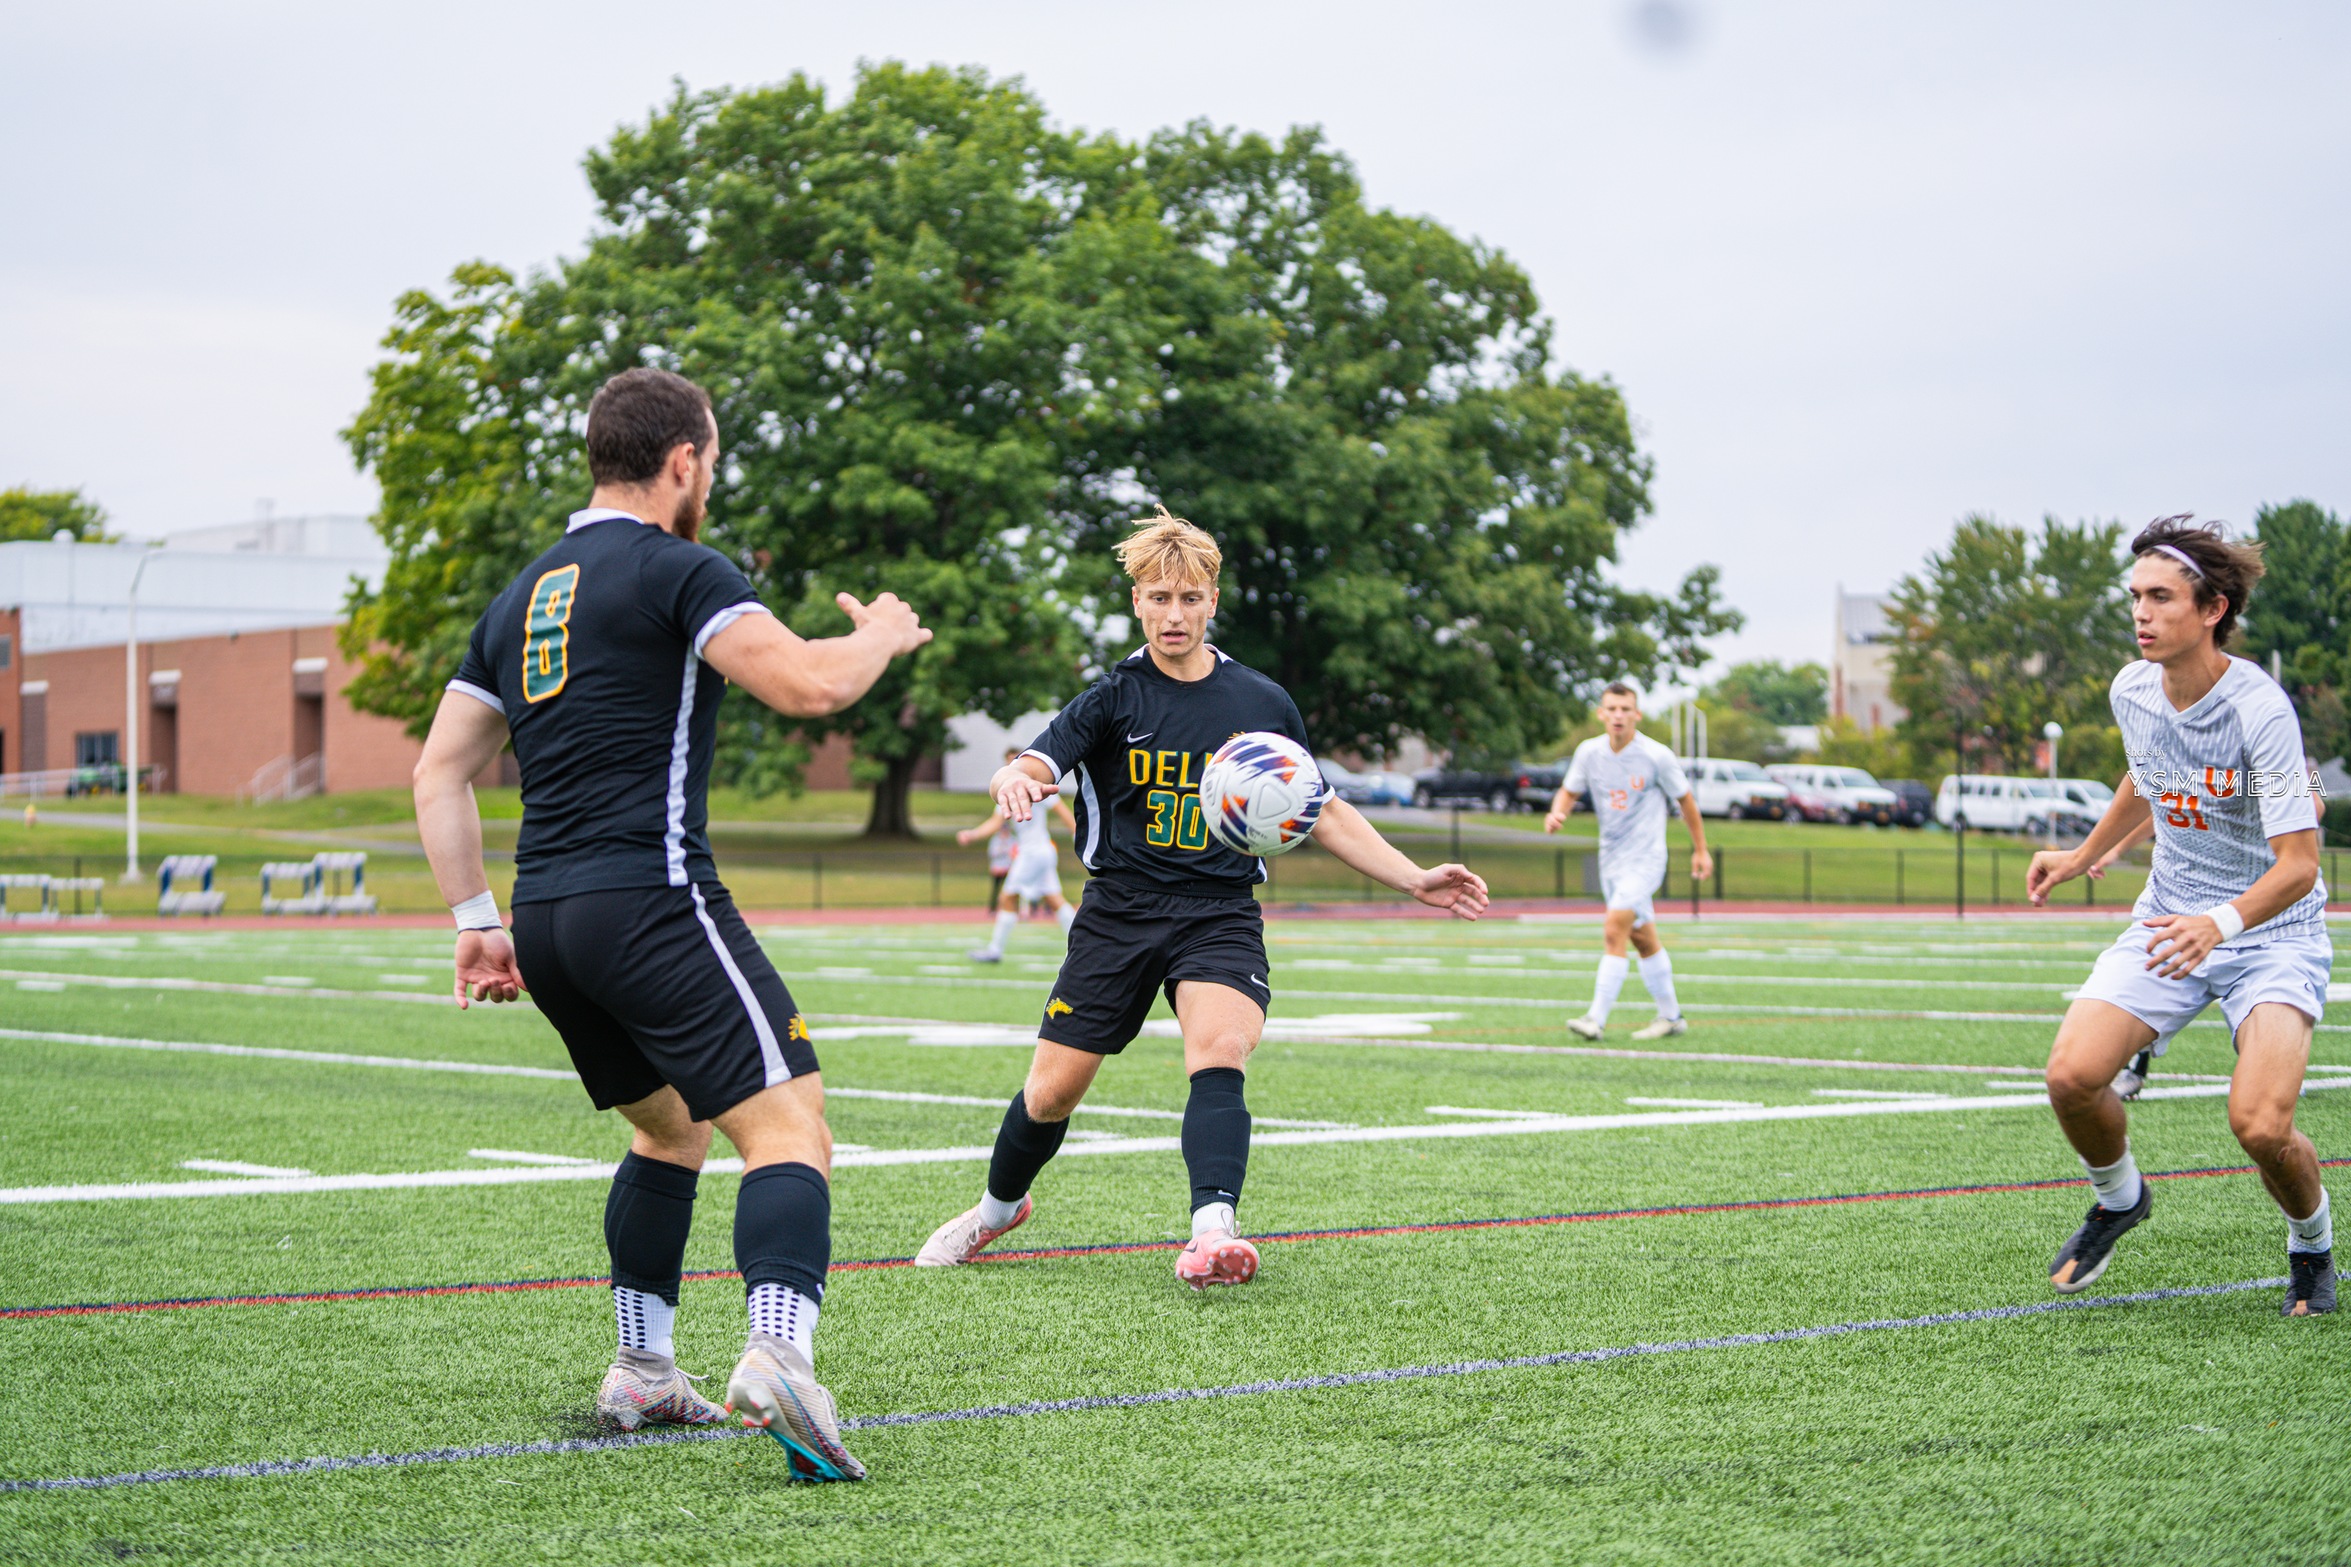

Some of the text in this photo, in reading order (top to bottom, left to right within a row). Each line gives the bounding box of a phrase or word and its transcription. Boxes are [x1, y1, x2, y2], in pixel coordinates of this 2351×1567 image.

[522, 563, 580, 704] 8
[1146, 789, 1209, 851] 30
[2160, 791, 2209, 831] 31
